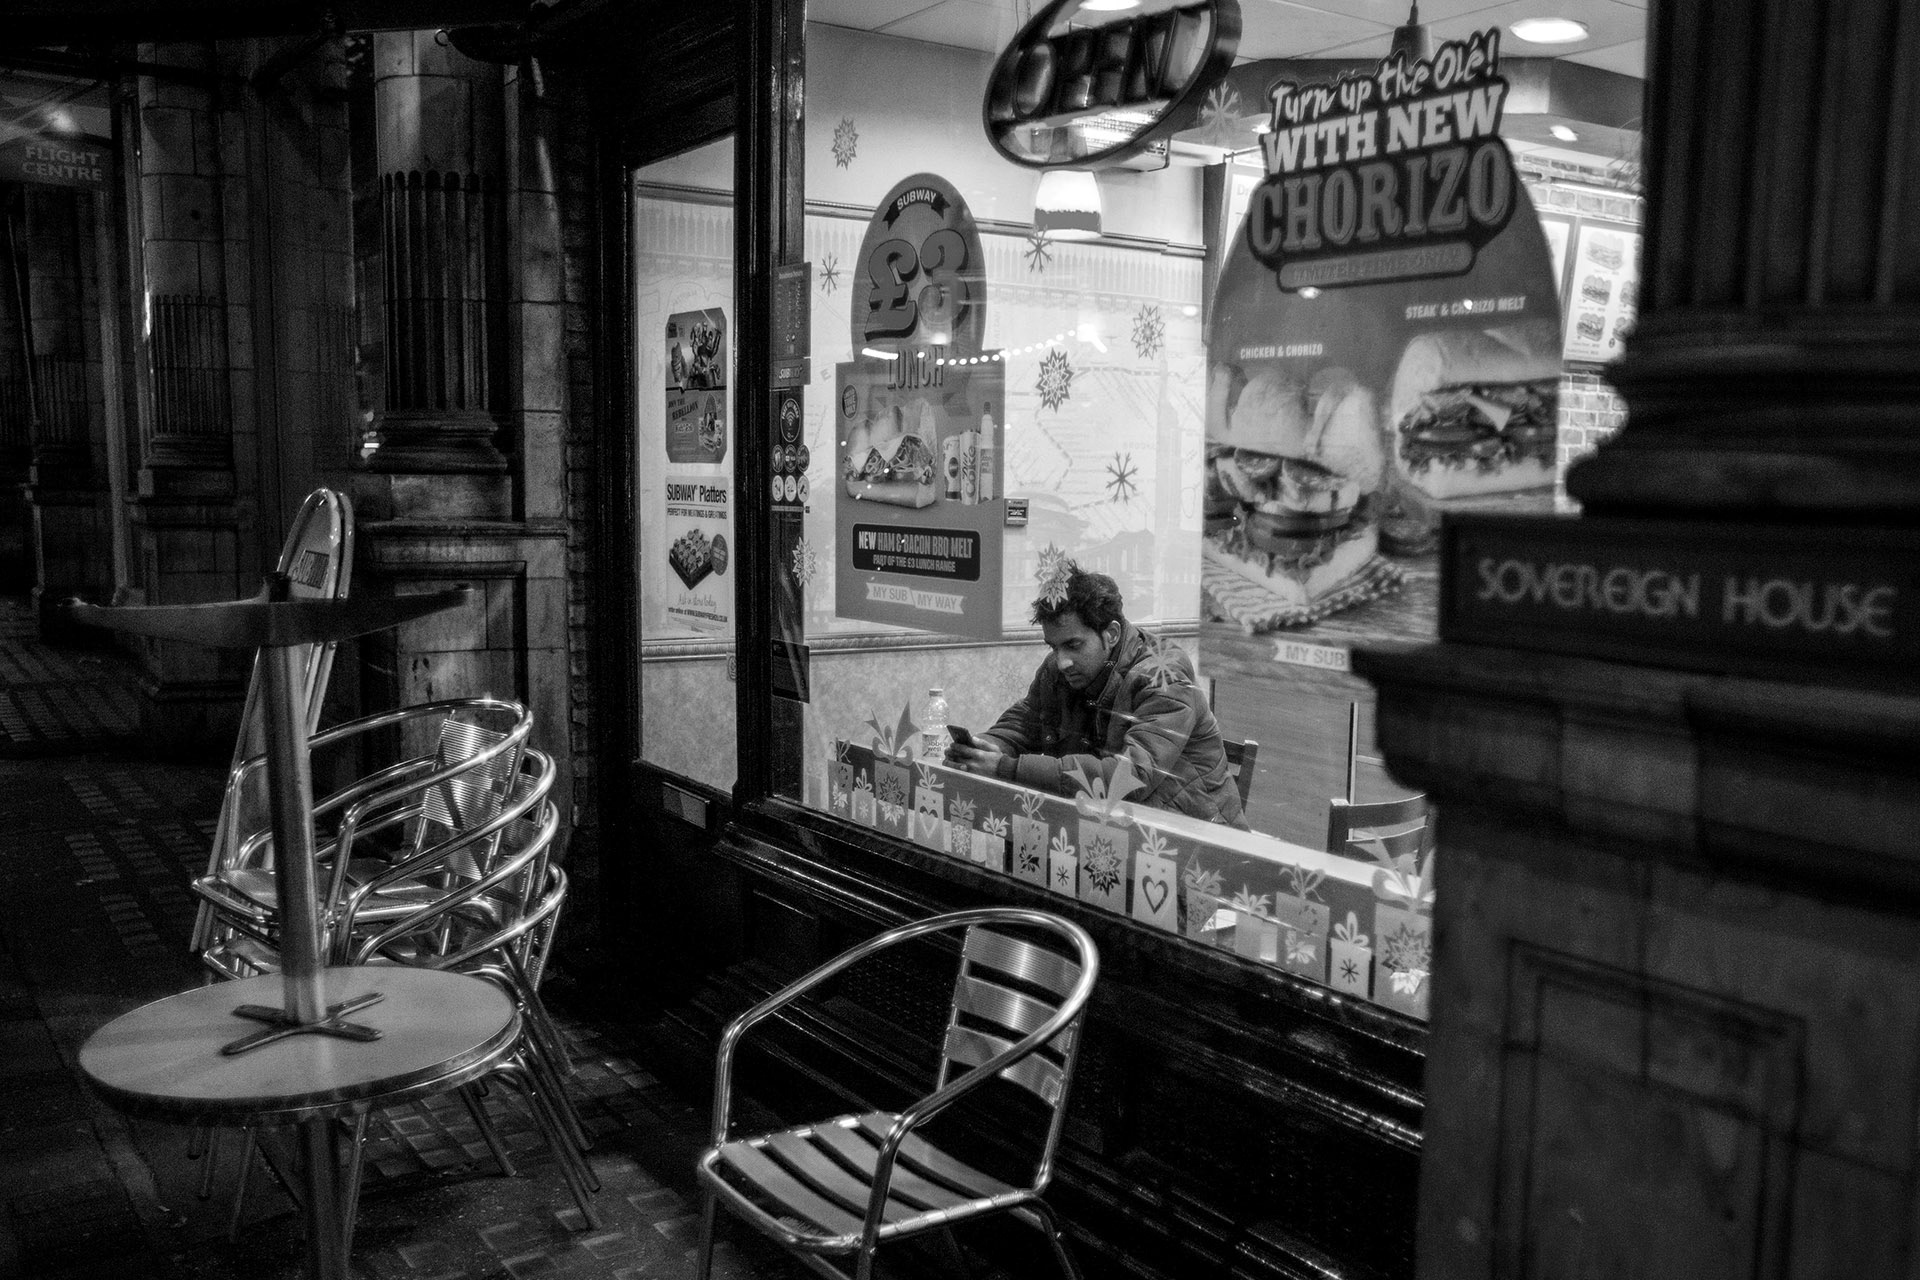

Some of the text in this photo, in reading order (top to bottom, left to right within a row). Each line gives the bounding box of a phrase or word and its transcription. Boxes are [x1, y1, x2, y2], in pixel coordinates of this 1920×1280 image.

[1011, 8, 1182, 121] OPEN
[1272, 34, 1497, 129] Turn up the Olé!
[1264, 83, 1505, 176] WITH NEW
[25, 146, 101, 166] FLIGHT
[22, 161, 102, 181] CENTRE
[896, 189, 937, 211] SUBWAY
[1249, 142, 1511, 255] CHORIZO
[864, 228, 970, 342] £3
[1440, 303, 1449, 316] &
[1497, 296, 1526, 311] MELT
[1240, 343, 1323, 359] CHICKEN & CHORIZO
[887, 344, 944, 391] LUNCH
[699, 485, 727, 503] Platters
[859, 531, 973, 558] NEW HAM & BACON BBQ MELT
[873, 554, 956, 572] PART OF THE £3 LUNCH RANGE
[873, 585, 957, 609] MY SUB MY WAY
[1722, 577, 1898, 637] HOUSE
[1285, 645, 1347, 667] MY SUB
